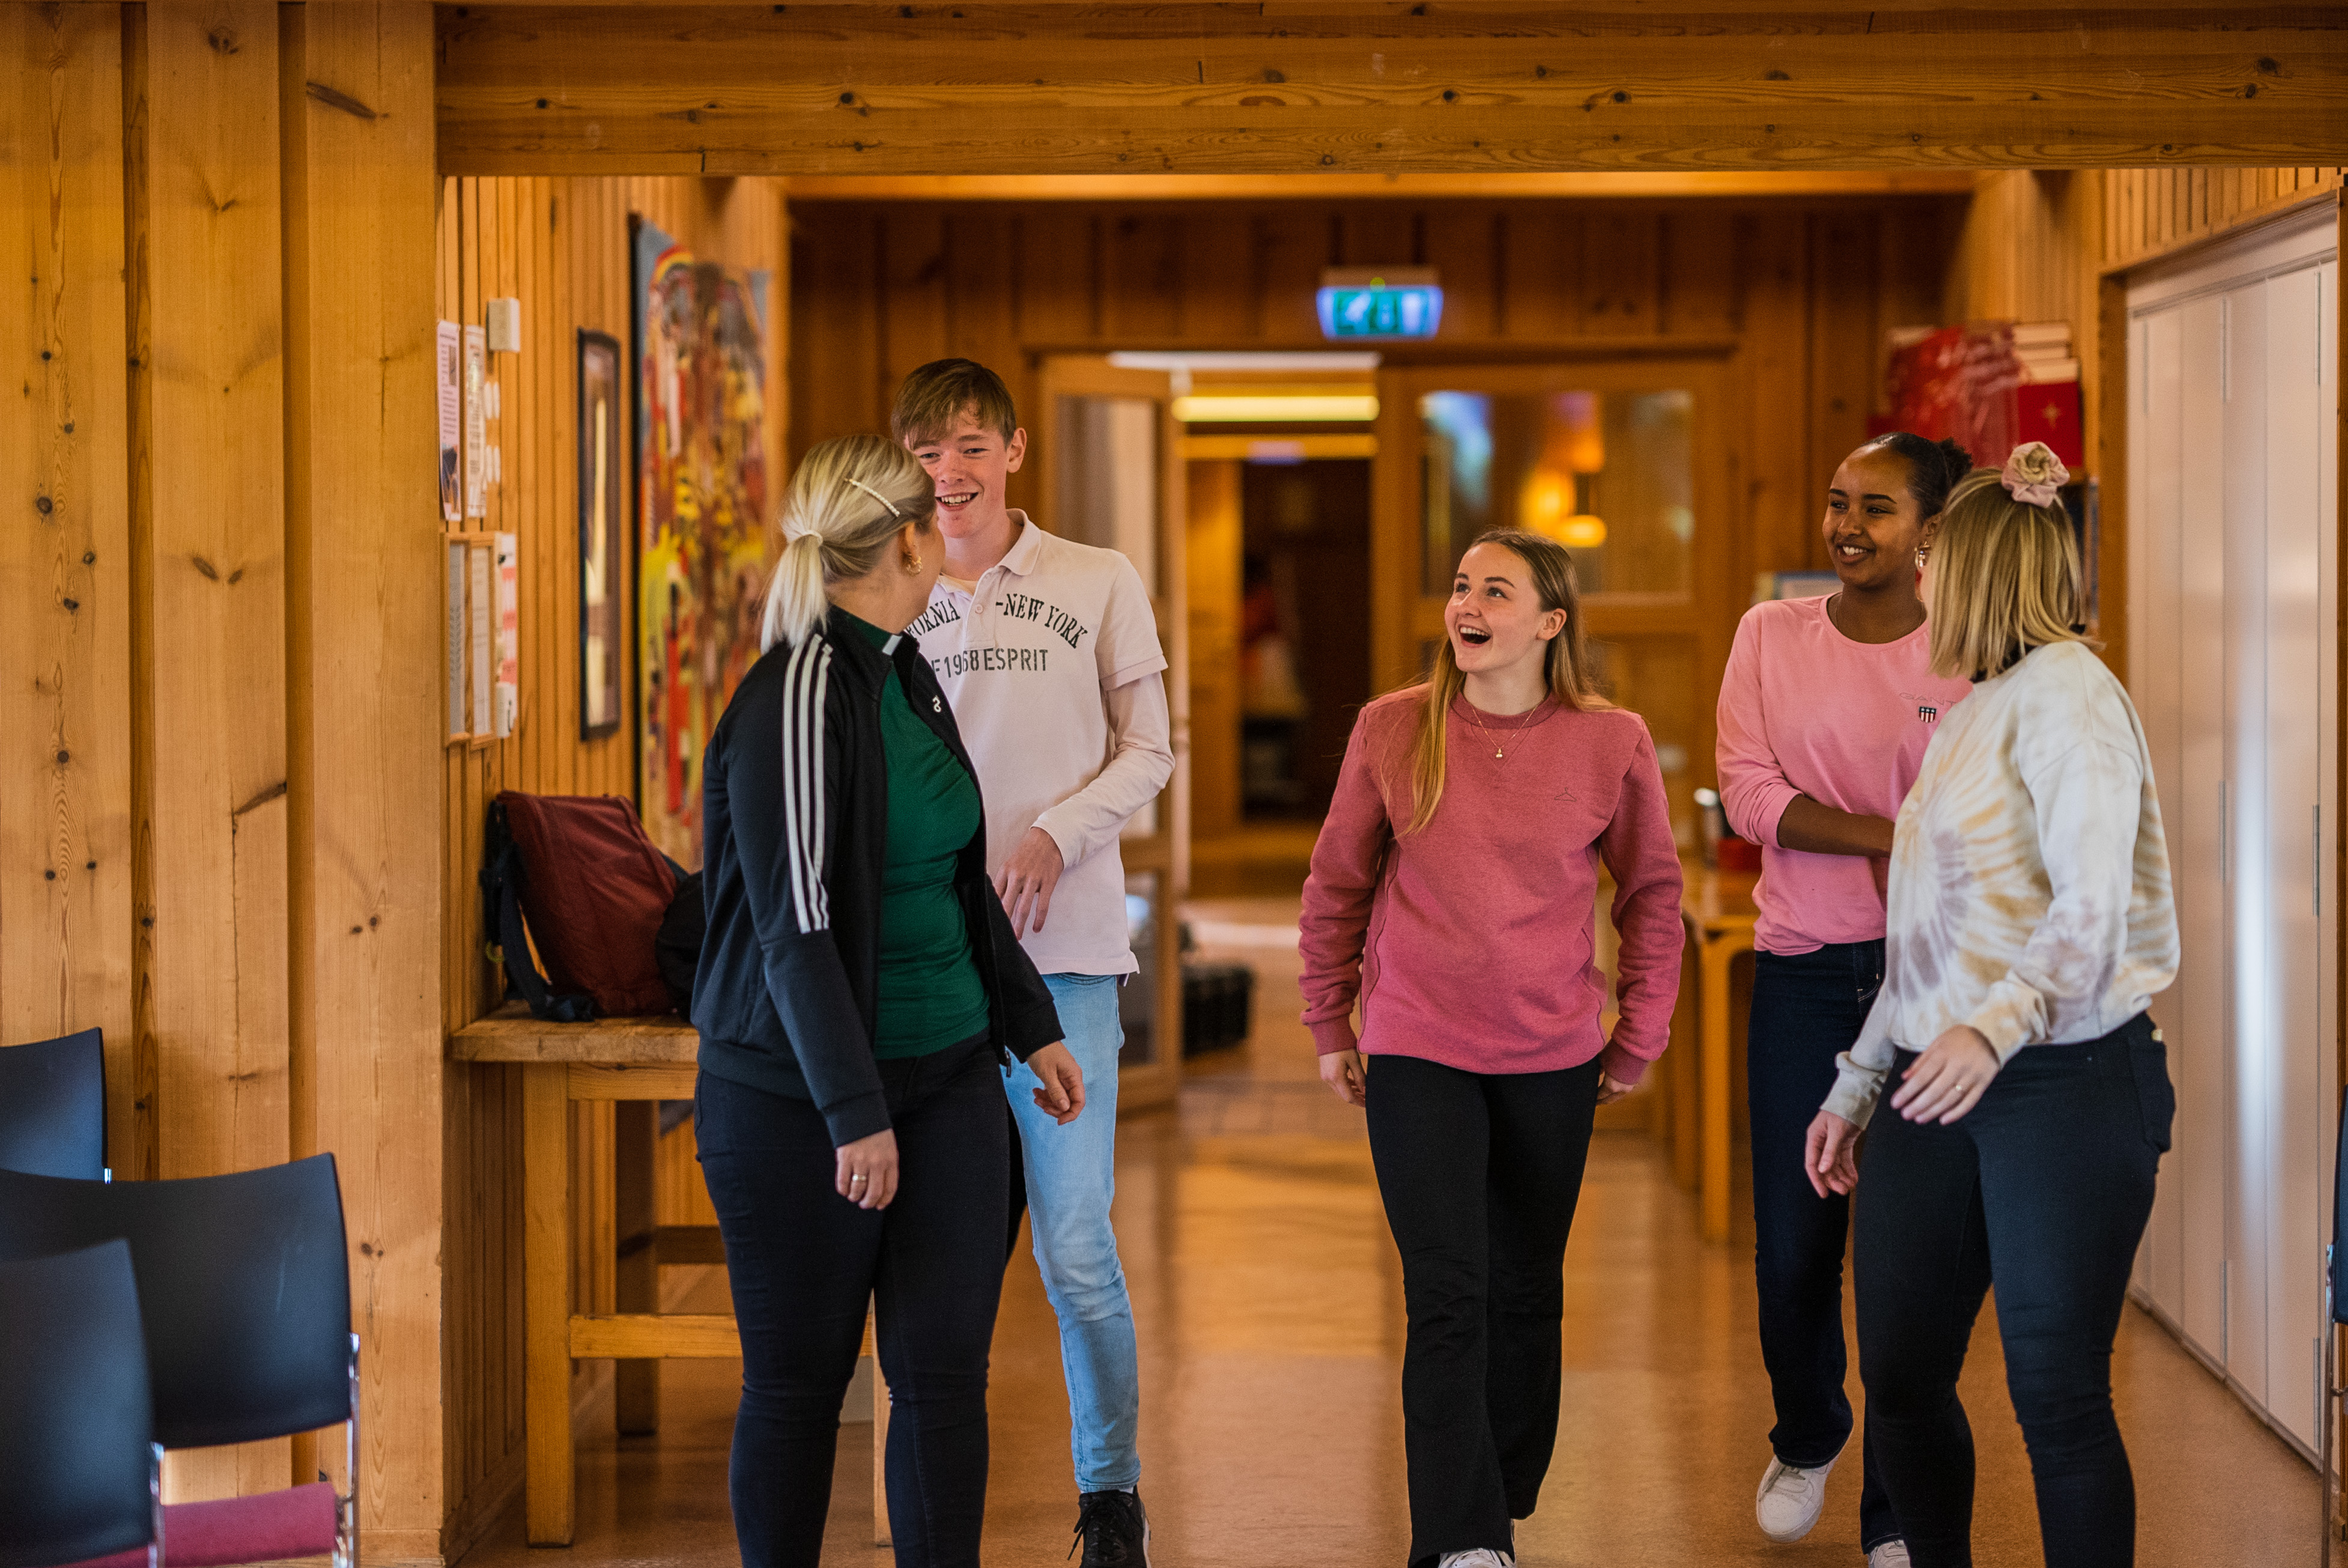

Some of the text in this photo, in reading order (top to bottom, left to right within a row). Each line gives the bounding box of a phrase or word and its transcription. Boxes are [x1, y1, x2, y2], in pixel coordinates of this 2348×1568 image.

[1045, 605, 1088, 649] YORK
[944, 650, 979, 678] 1968
[983, 648, 1048, 671] ESPRIT
[1899, 692, 1957, 707] GANT
